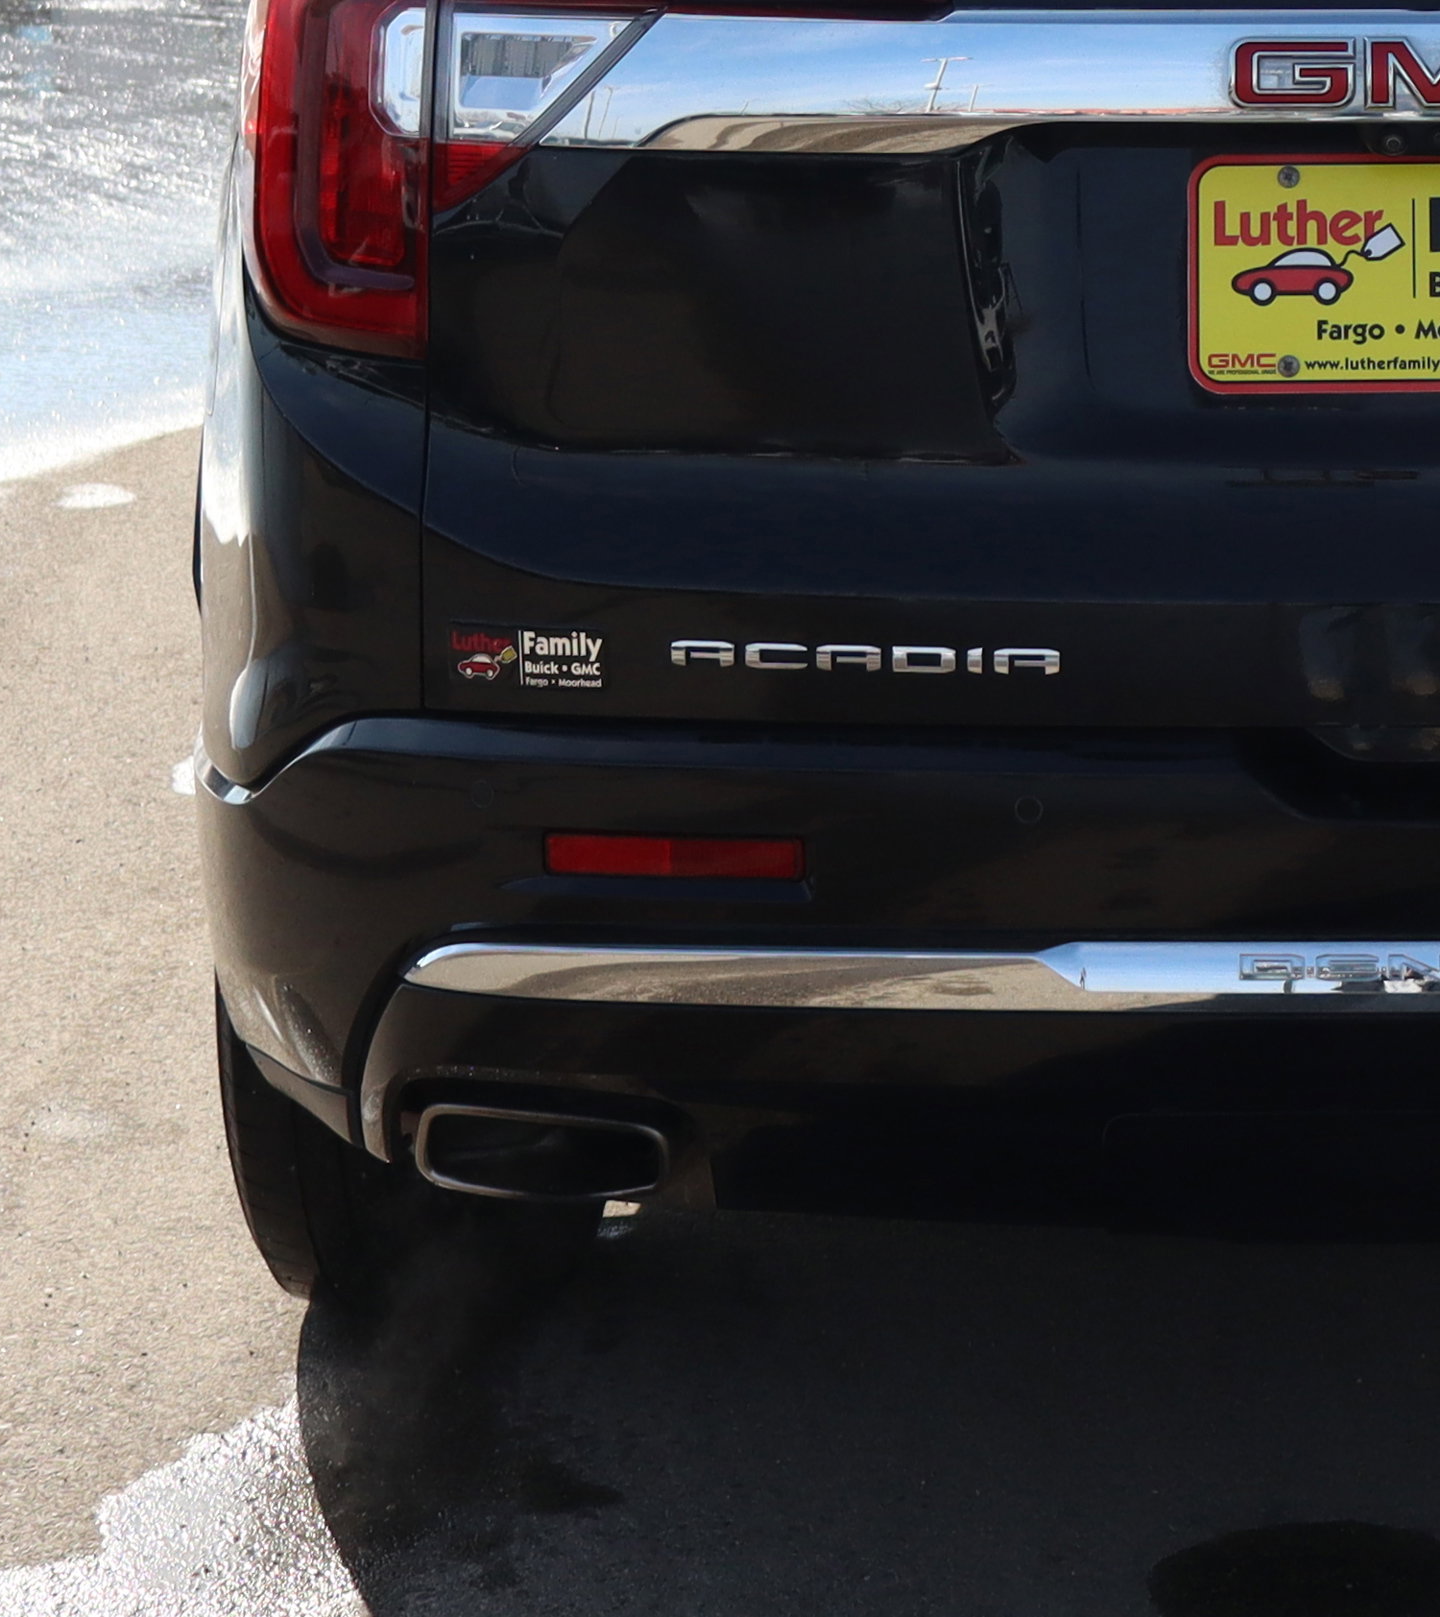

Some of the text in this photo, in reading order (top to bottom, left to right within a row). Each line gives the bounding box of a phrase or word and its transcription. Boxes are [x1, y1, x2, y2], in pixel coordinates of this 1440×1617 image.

[1213, 199, 1384, 247] Luther
[1316, 319, 1385, 345] Fargo
[1208, 353, 1276, 368] GMC
[523, 631, 602, 662] Family
[670, 639, 1061, 676] ACADIA
[524, 661, 600, 676] Buick GMC
[525, 676, 602, 688] Fargo Moorhead
